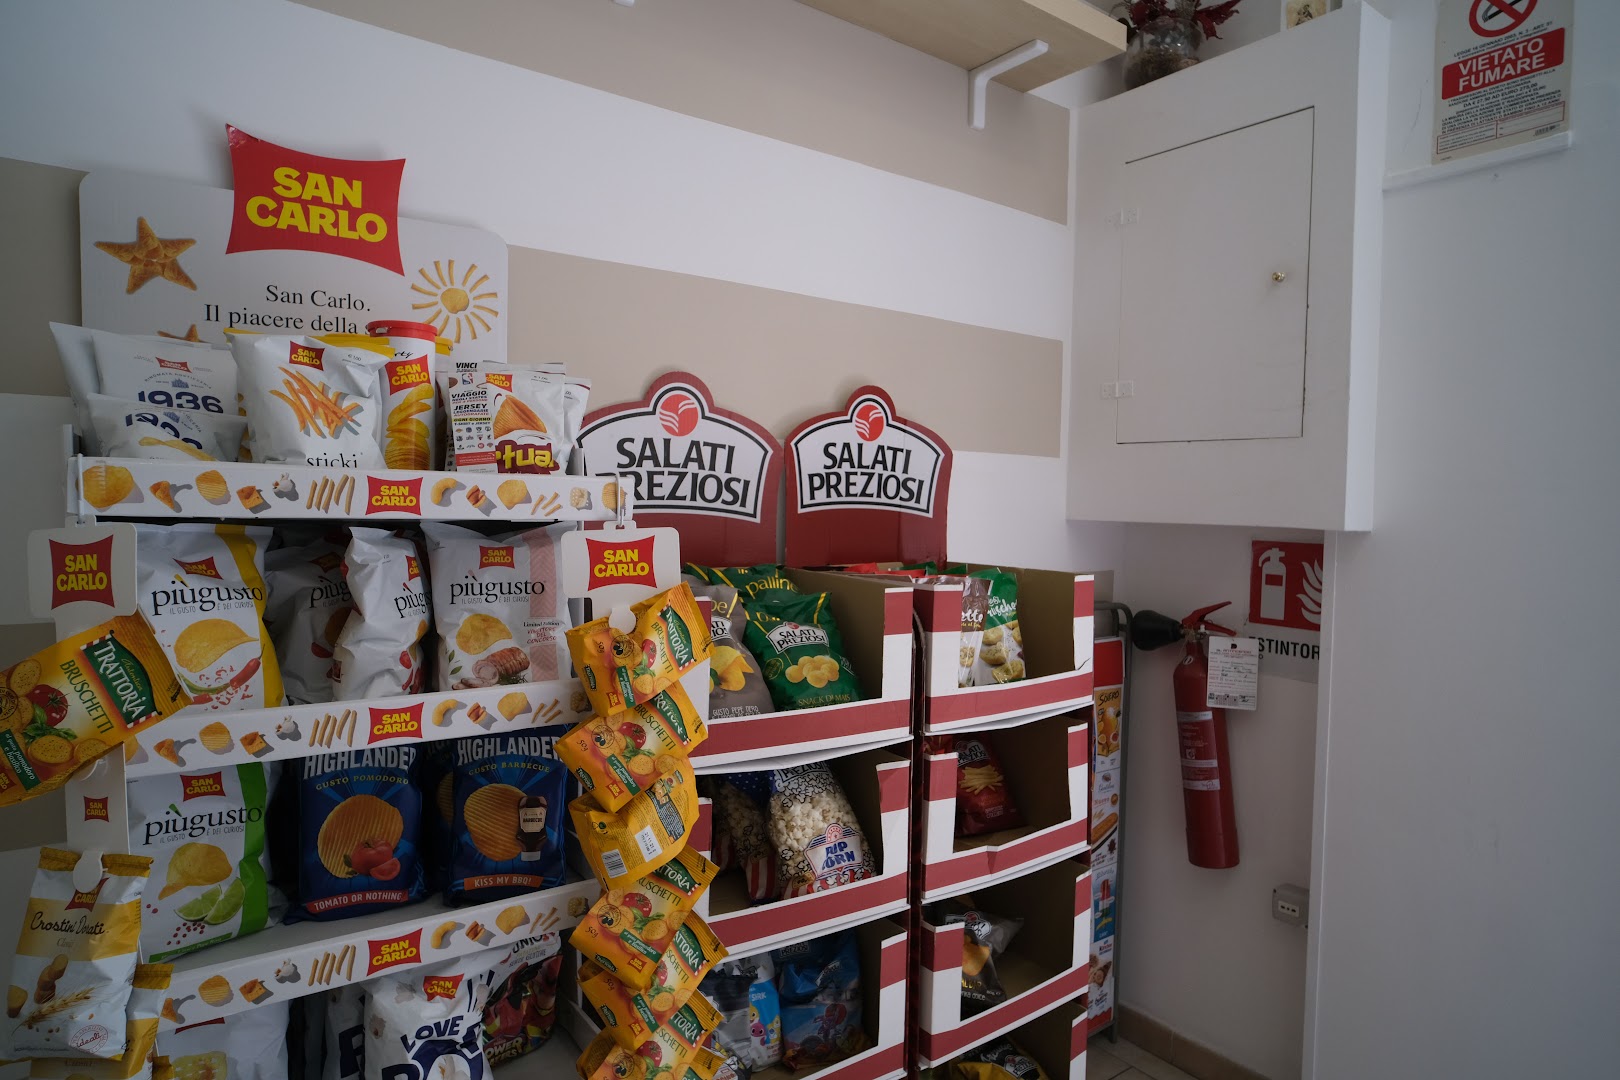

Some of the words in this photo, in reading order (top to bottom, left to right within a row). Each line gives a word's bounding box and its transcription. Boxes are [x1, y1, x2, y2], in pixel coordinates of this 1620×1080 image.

[1459, 38, 1544, 75] VIETATO
[1459, 53, 1545, 92] FUMARE
[273, 167, 362, 208] SAN
[246, 196, 387, 242] CARLO
[266, 285, 303, 304] San
[311, 290, 371, 312] Carlo.
[204, 304, 219, 322] Il
[228, 308, 304, 329] piacere
[311, 315, 357, 334] della
[291, 355, 320, 365] CARLO
[297, 349, 316, 358] SAN
[396, 363, 421, 374] SAN
[391, 372, 428, 386] CARLO
[486, 376, 510, 387] CARLO
[452, 390, 487, 398] VIAGGIO
[138, 391, 223, 414] 1936
[306, 452, 358, 468] sticki
[616, 437, 735, 474] SALATI
[823, 442, 912, 475] SALATI
[380, 486, 409, 496] SAN
[596, 471, 751, 509] REZIOSI
[808, 471, 925, 505] PREZIOSI
[372, 496, 416, 506] CARLO
[65, 554, 97, 572] SAN
[482, 556, 511, 564] CARLO
[604, 549, 638, 563] SAN
[594, 562, 649, 578] CARLO
[57, 572, 107, 591] CARLO
[450, 570, 545, 604] piùgusto
[151, 574, 263, 616] piùgusto
[178, 605, 196, 614] GUSTO
[235, 601, 254, 609] CURIOSI
[777, 634, 826, 649] PREZIOSI
[779, 628, 816, 639] SALATI
[1249, 636, 1320, 660] STINTOR
[94, 641, 146, 719] TRATTORIA
[60, 659, 114, 734] BRUSCHETTI
[382, 713, 411, 724] SAN
[713, 707, 729, 716] GUSTO
[374, 721, 418, 735] CARLO
[634, 703, 676, 750] BRUSCHETTI
[469, 764, 496, 776] GUSTO
[501, 762, 550, 773] BARBECUE
[186, 784, 220, 794] CARLO
[192, 778, 213, 787] SAN
[316, 777, 349, 790] GUSTO
[353, 776, 408, 785] POMODORO
[143, 803, 263, 845] piùgusto
[167, 834, 185, 842] GUSTO
[224, 826, 244, 834] CURIOSI
[474, 879, 493, 887] KISS
[512, 877, 531, 885] BBQ!
[314, 896, 349, 911] TOMATO
[352, 894, 362, 902] OR
[366, 892, 402, 900] NOTHING
[30, 911, 75, 933] Crostini
[380, 940, 409, 954] SAN
[373, 947, 416, 966] CARLO
[427, 985, 455, 996] CARLO
[432, 980, 453, 988] SAN
[400, 1015, 464, 1053] LOVE
[485, 1037, 522, 1059] OWER
